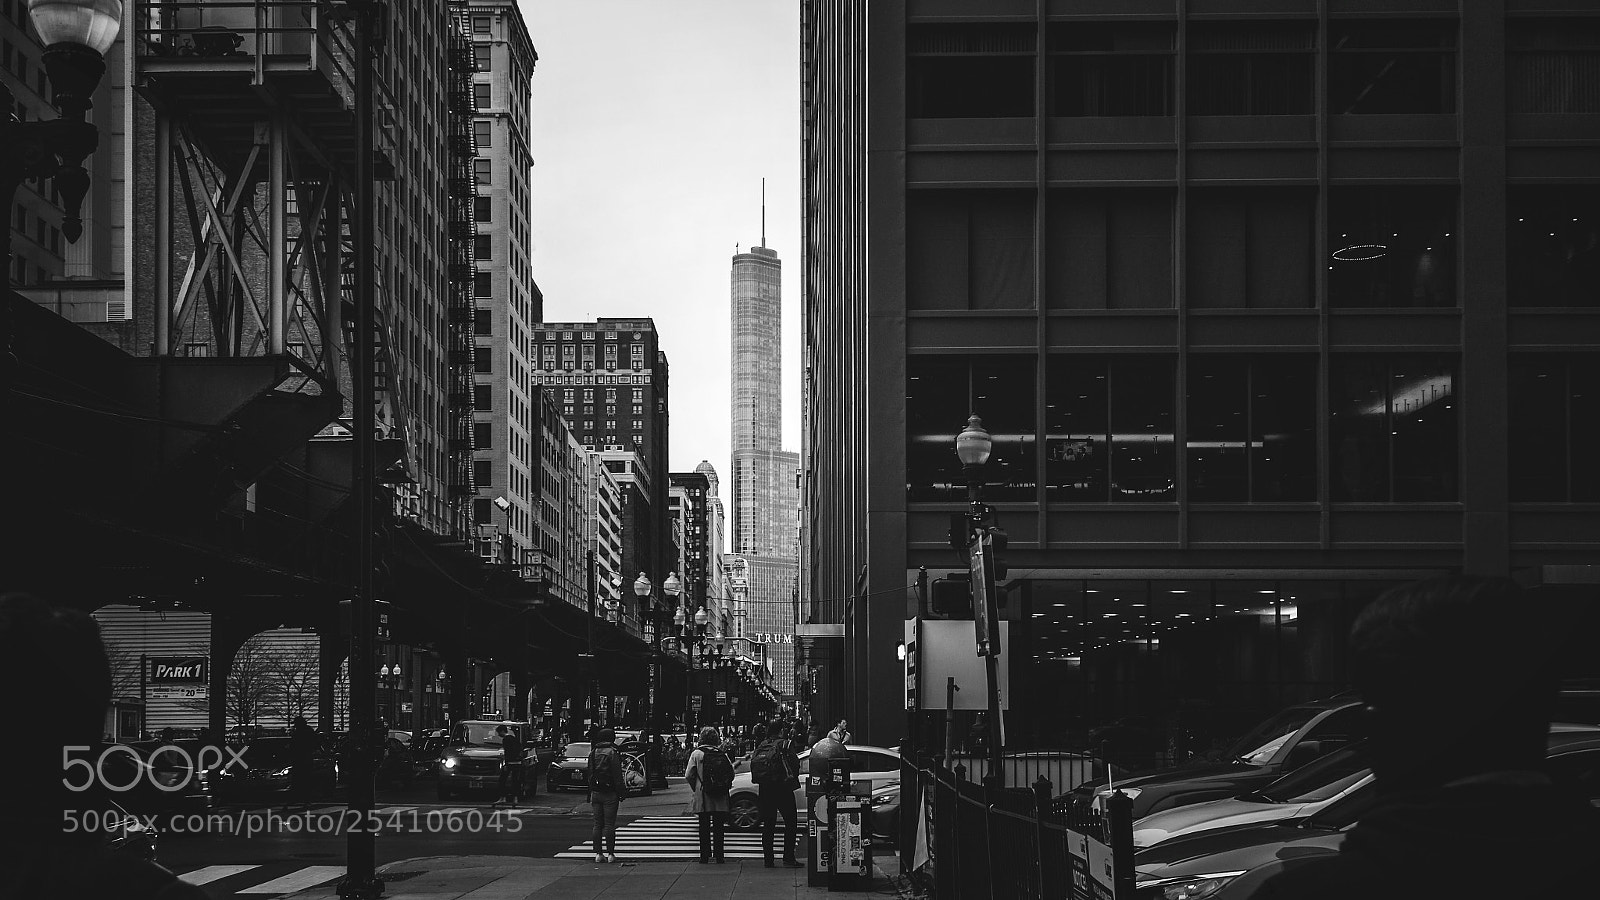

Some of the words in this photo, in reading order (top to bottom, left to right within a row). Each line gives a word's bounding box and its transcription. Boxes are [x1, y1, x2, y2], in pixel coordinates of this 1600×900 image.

[755, 633, 792, 644] TRUM
[155, 664, 193, 678] PARK
[194, 663, 202, 678] 1
[185, 689, 196, 697] 20
